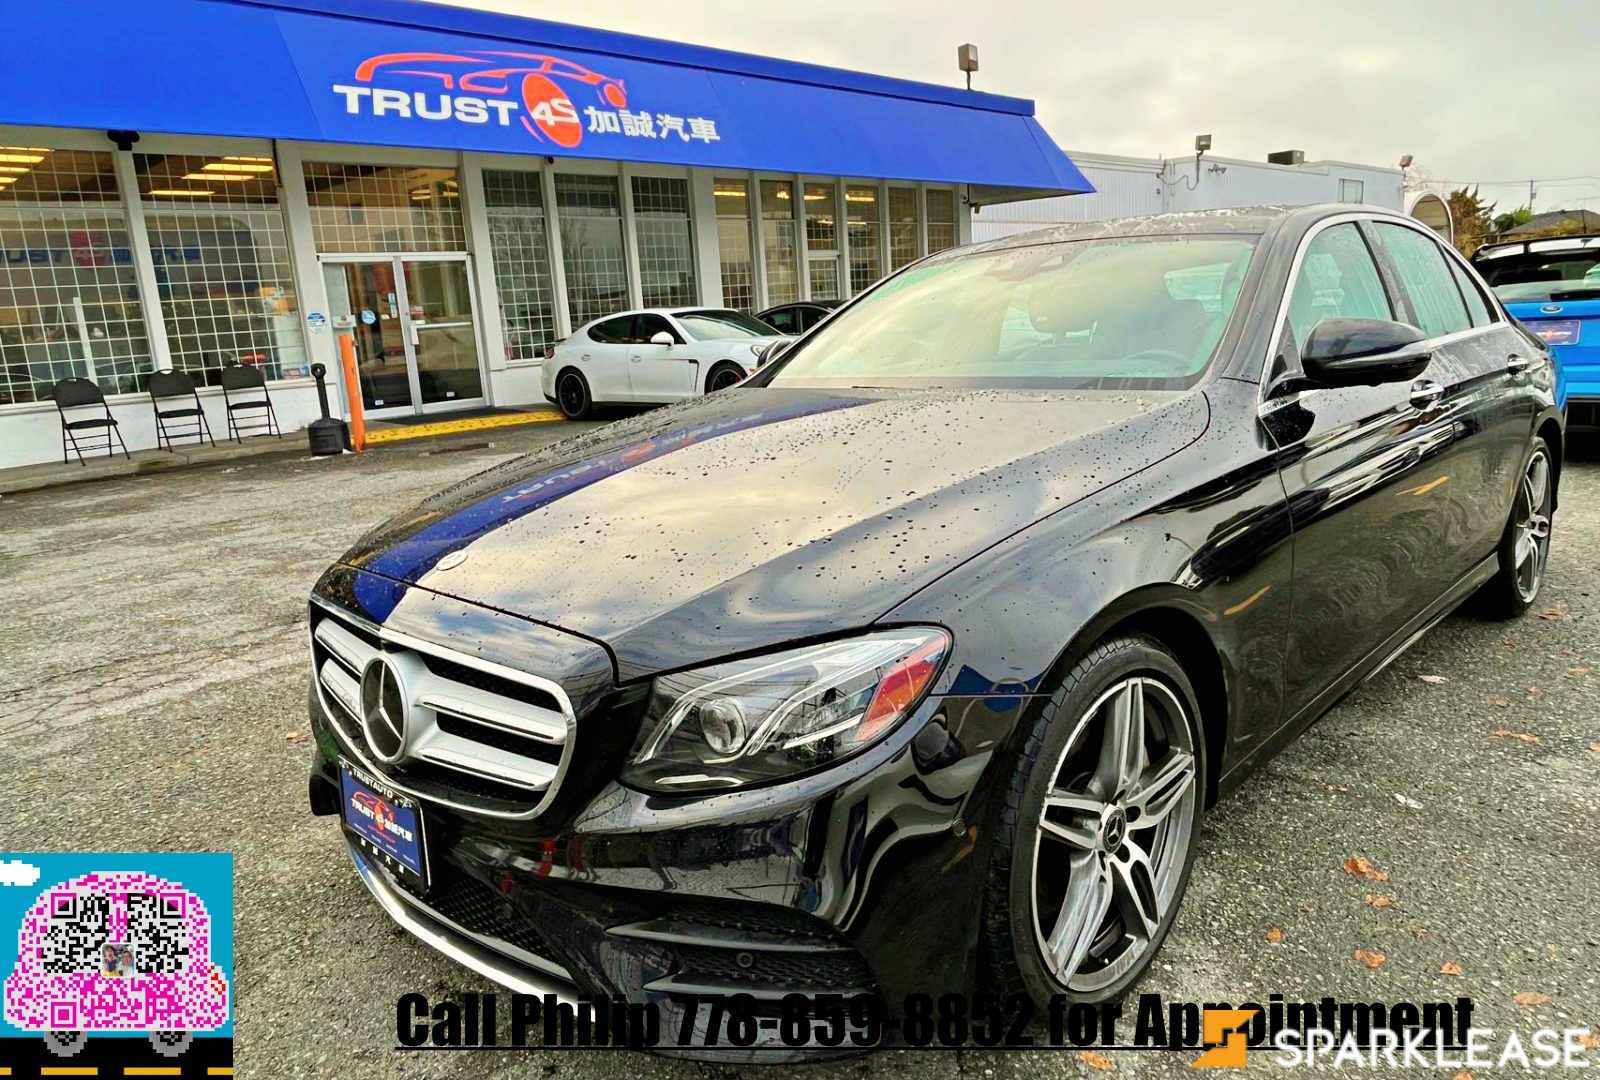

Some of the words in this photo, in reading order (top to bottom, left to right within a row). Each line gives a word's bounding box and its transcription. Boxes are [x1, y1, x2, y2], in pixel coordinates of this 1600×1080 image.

[333, 84, 519, 126] TRUST
[531, 98, 580, 125] 4S
[584, 106, 720, 143] 加誠汽車
[353, 768, 393, 798] TRUSTAUTO
[351, 798, 375, 820] TRUST
